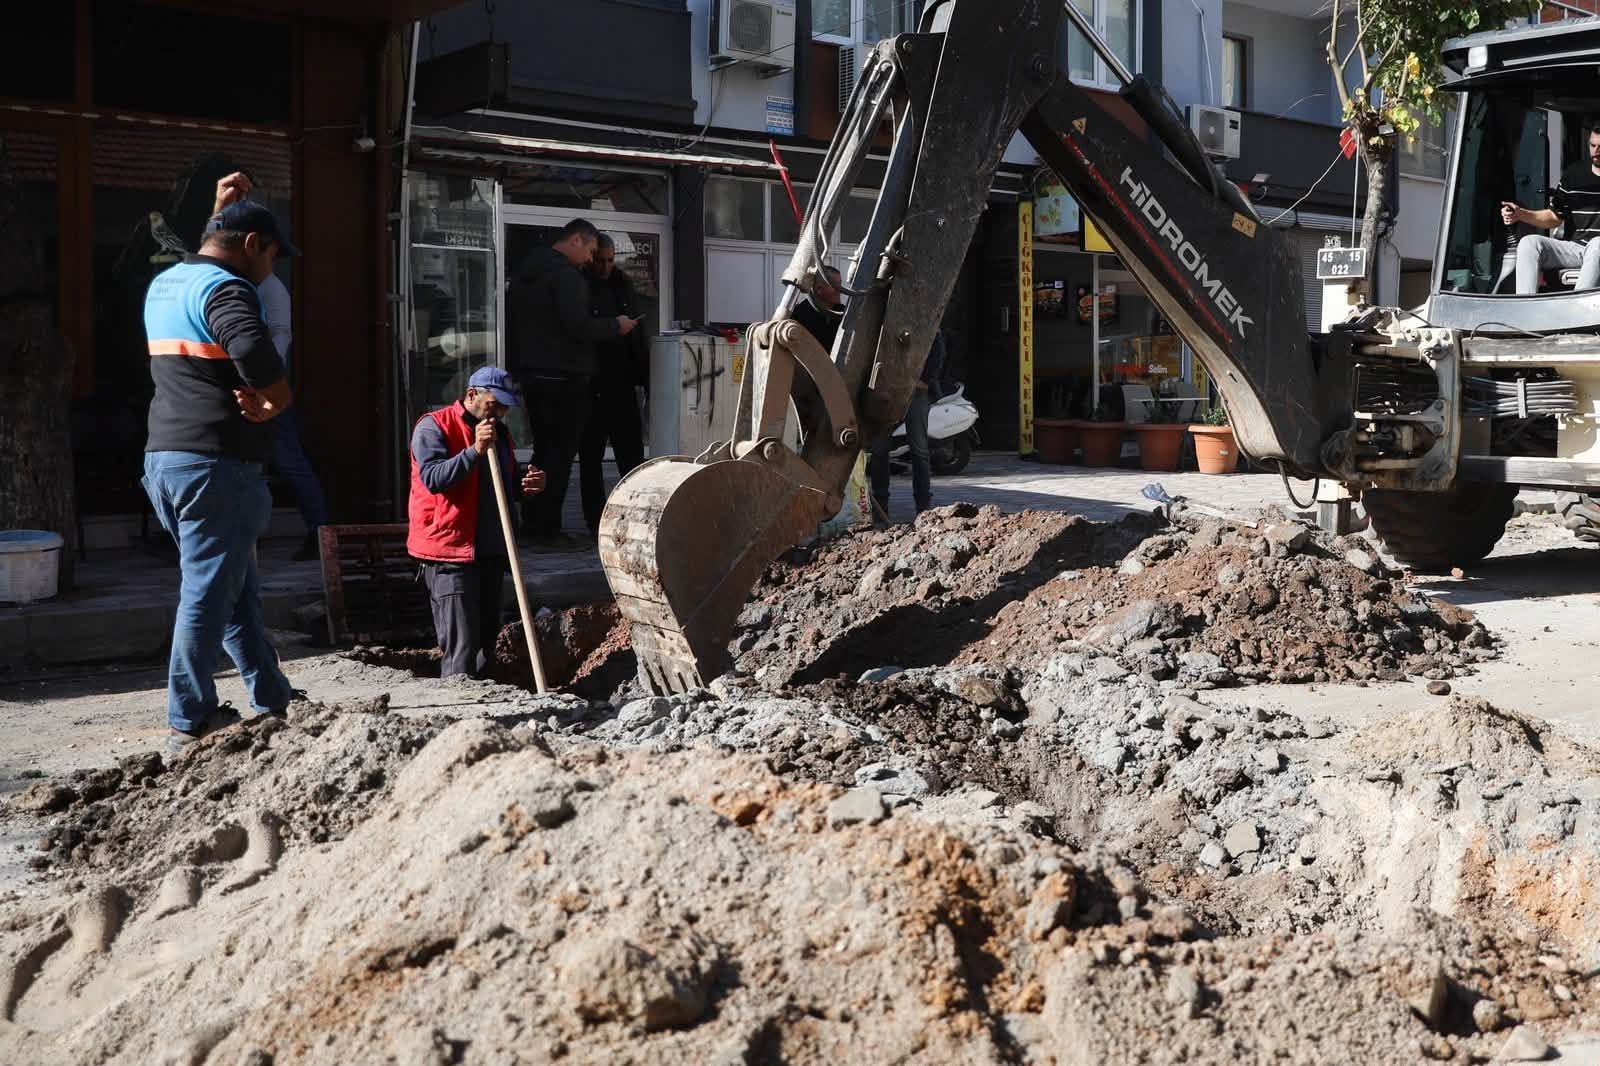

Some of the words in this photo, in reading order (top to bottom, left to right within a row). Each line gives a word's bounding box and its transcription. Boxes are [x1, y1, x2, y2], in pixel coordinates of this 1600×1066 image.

[1119, 165, 1254, 339] HİDROMEK
[1321, 252, 1334, 263] 45
[1349, 251, 1361, 262] 15
[1331, 264, 1349, 275] 022
